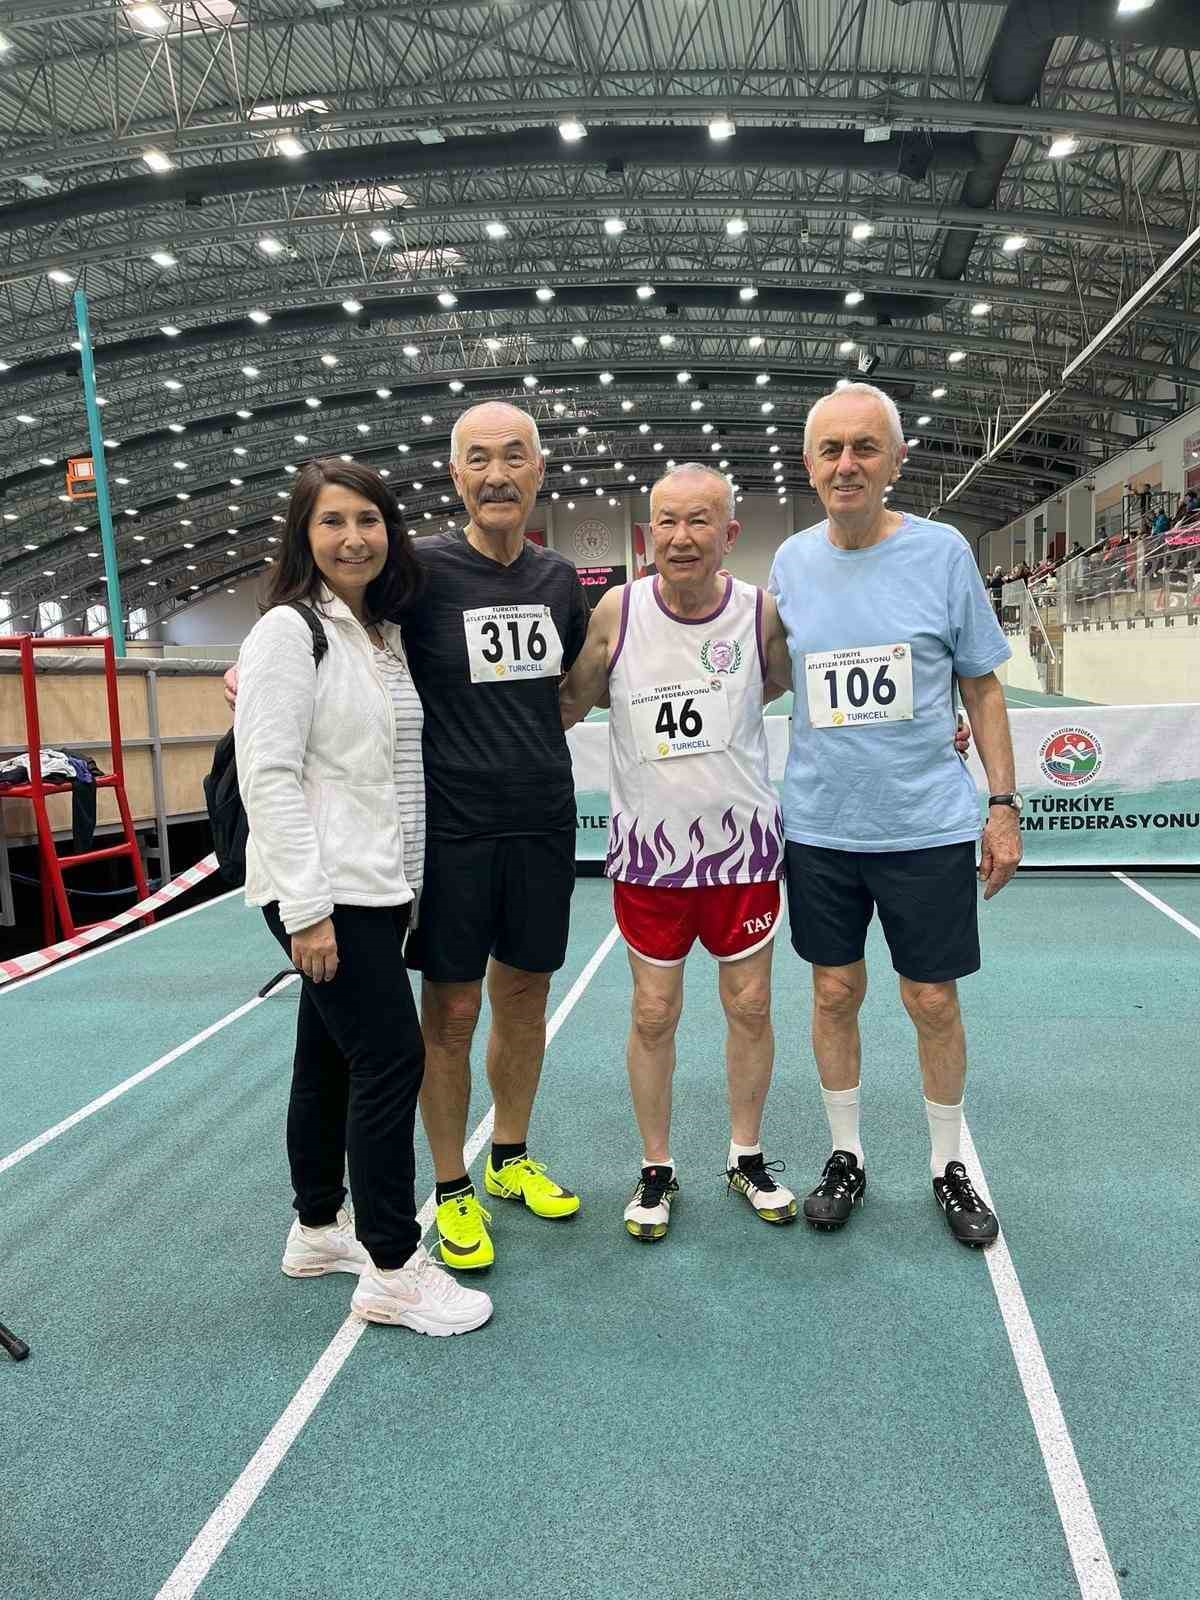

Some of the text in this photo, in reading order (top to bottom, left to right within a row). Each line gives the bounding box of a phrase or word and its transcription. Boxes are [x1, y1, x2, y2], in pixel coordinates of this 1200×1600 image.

[499, 612, 543, 622] FEDERASYONU
[480, 620, 547, 664] 316
[839, 655, 891, 667] FEDERASYONU
[508, 664, 544, 673] TURKCELL
[824, 664, 897, 709] 106
[661, 688, 710, 700] FEDERASYONU
[655, 698, 703, 740] 46
[847, 711, 889, 721] TURKCELL
[671, 740, 711, 751] TURKCELL
[1029, 794, 1114, 813] TÜRKİYE
[576, 815, 609, 829] TLE
[1049, 813, 1199, 830] FEDERASYONU
[743, 911, 772, 934] TAF
